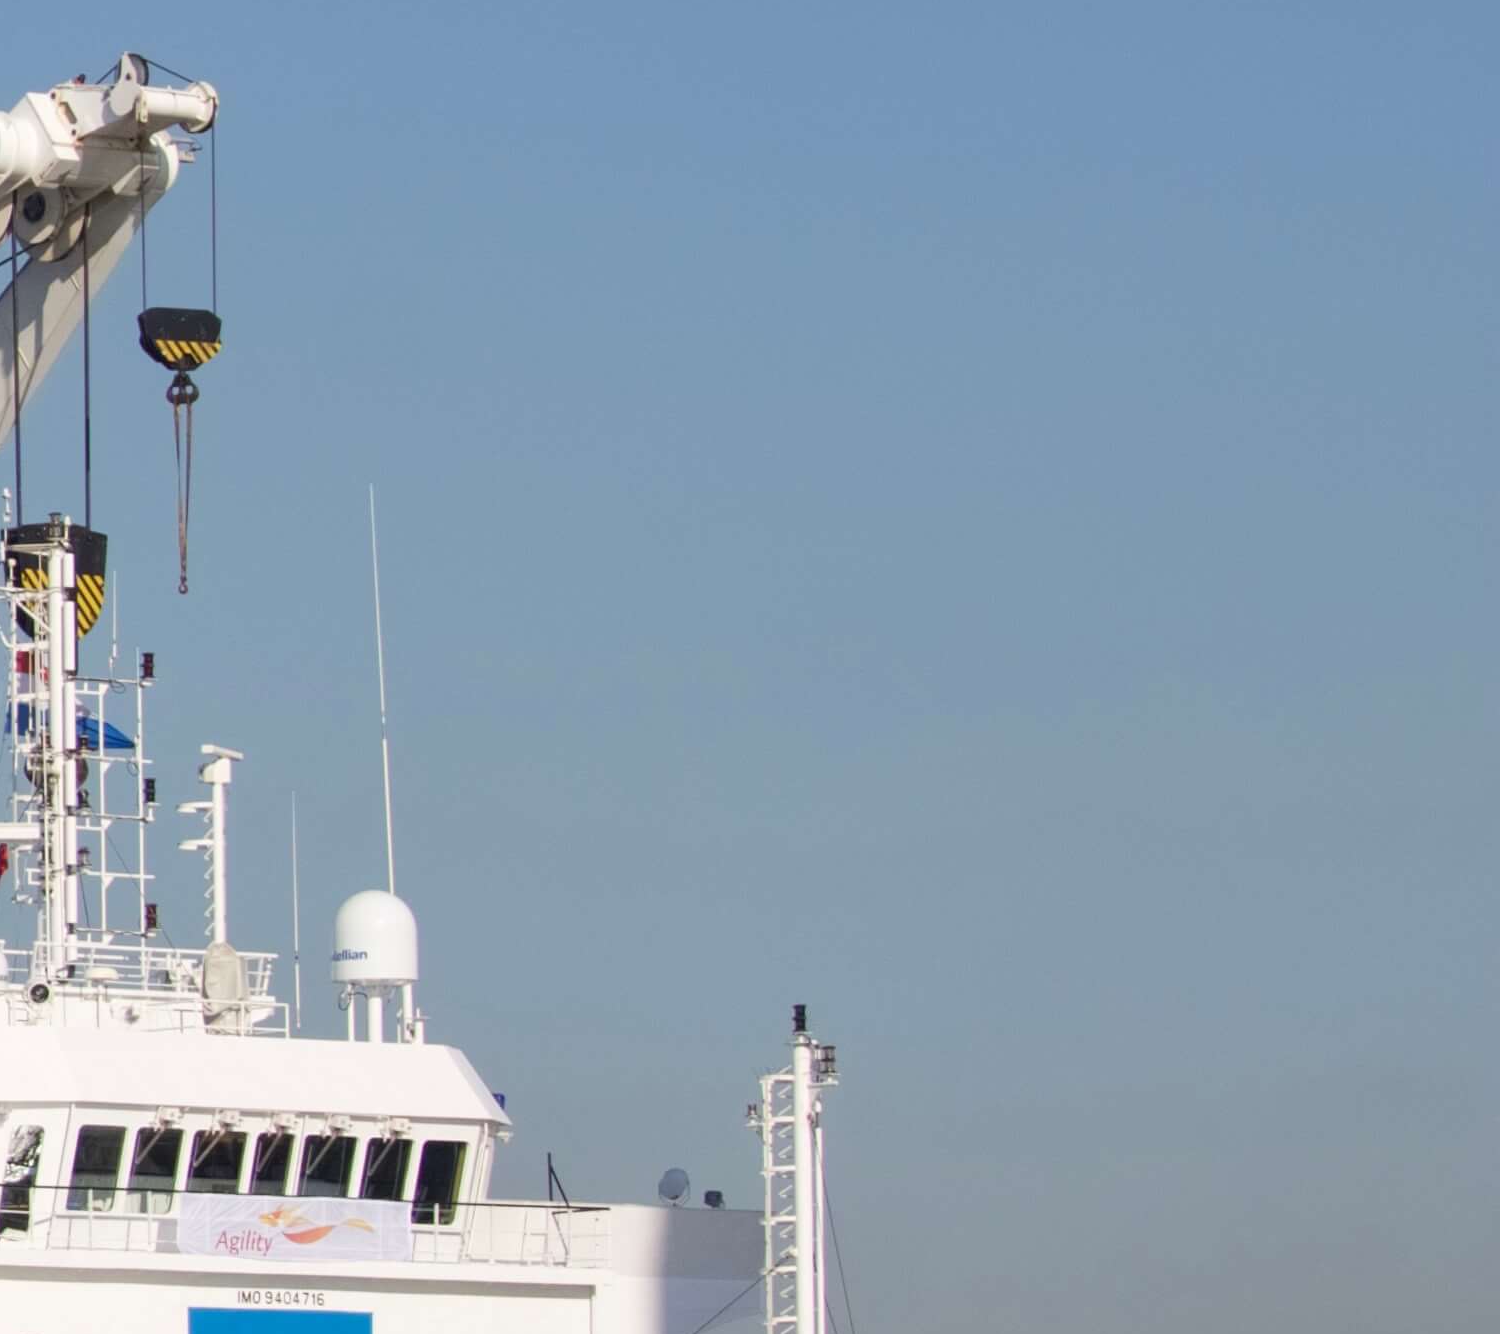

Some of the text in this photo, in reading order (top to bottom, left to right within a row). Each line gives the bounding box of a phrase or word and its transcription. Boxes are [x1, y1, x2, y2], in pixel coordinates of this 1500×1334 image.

[215, 1230, 273, 1256] Agility
[237, 1291, 325, 1305] IMO 9404716
